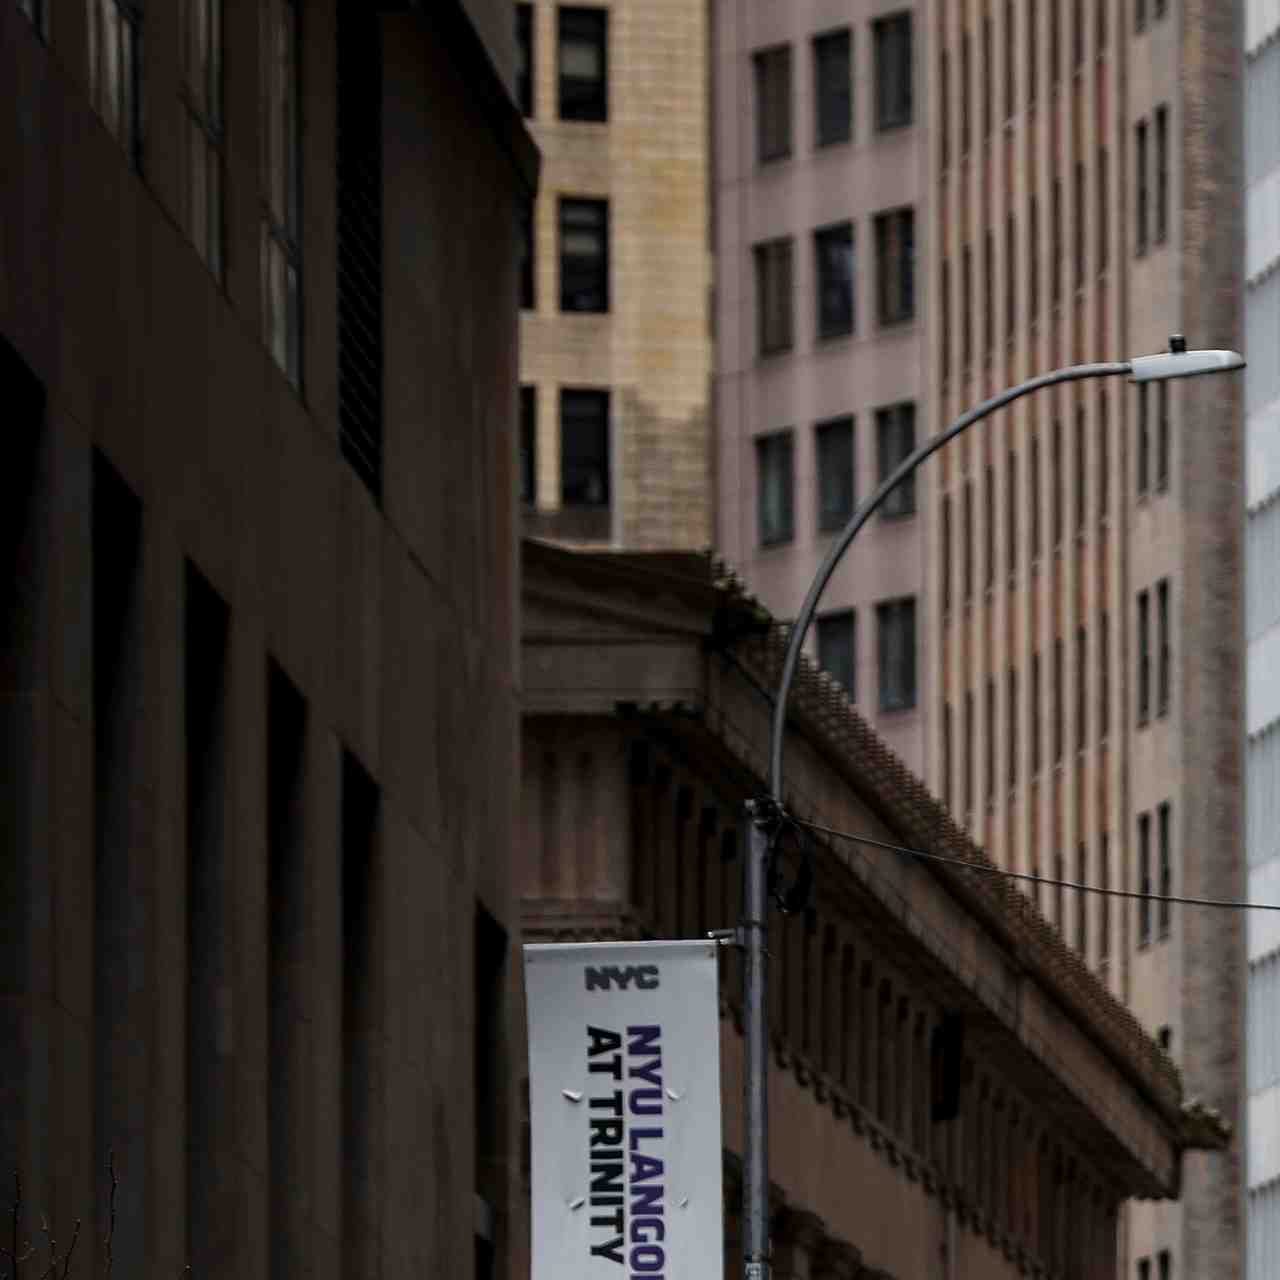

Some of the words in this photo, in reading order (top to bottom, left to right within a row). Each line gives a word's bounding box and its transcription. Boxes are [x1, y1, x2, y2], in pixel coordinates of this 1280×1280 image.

[584, 965, 660, 991] NYC
[586, 1025, 623, 1081] AT
[626, 1025, 664, 1116] NYU
[588, 1090, 626, 1265] TRINITY
